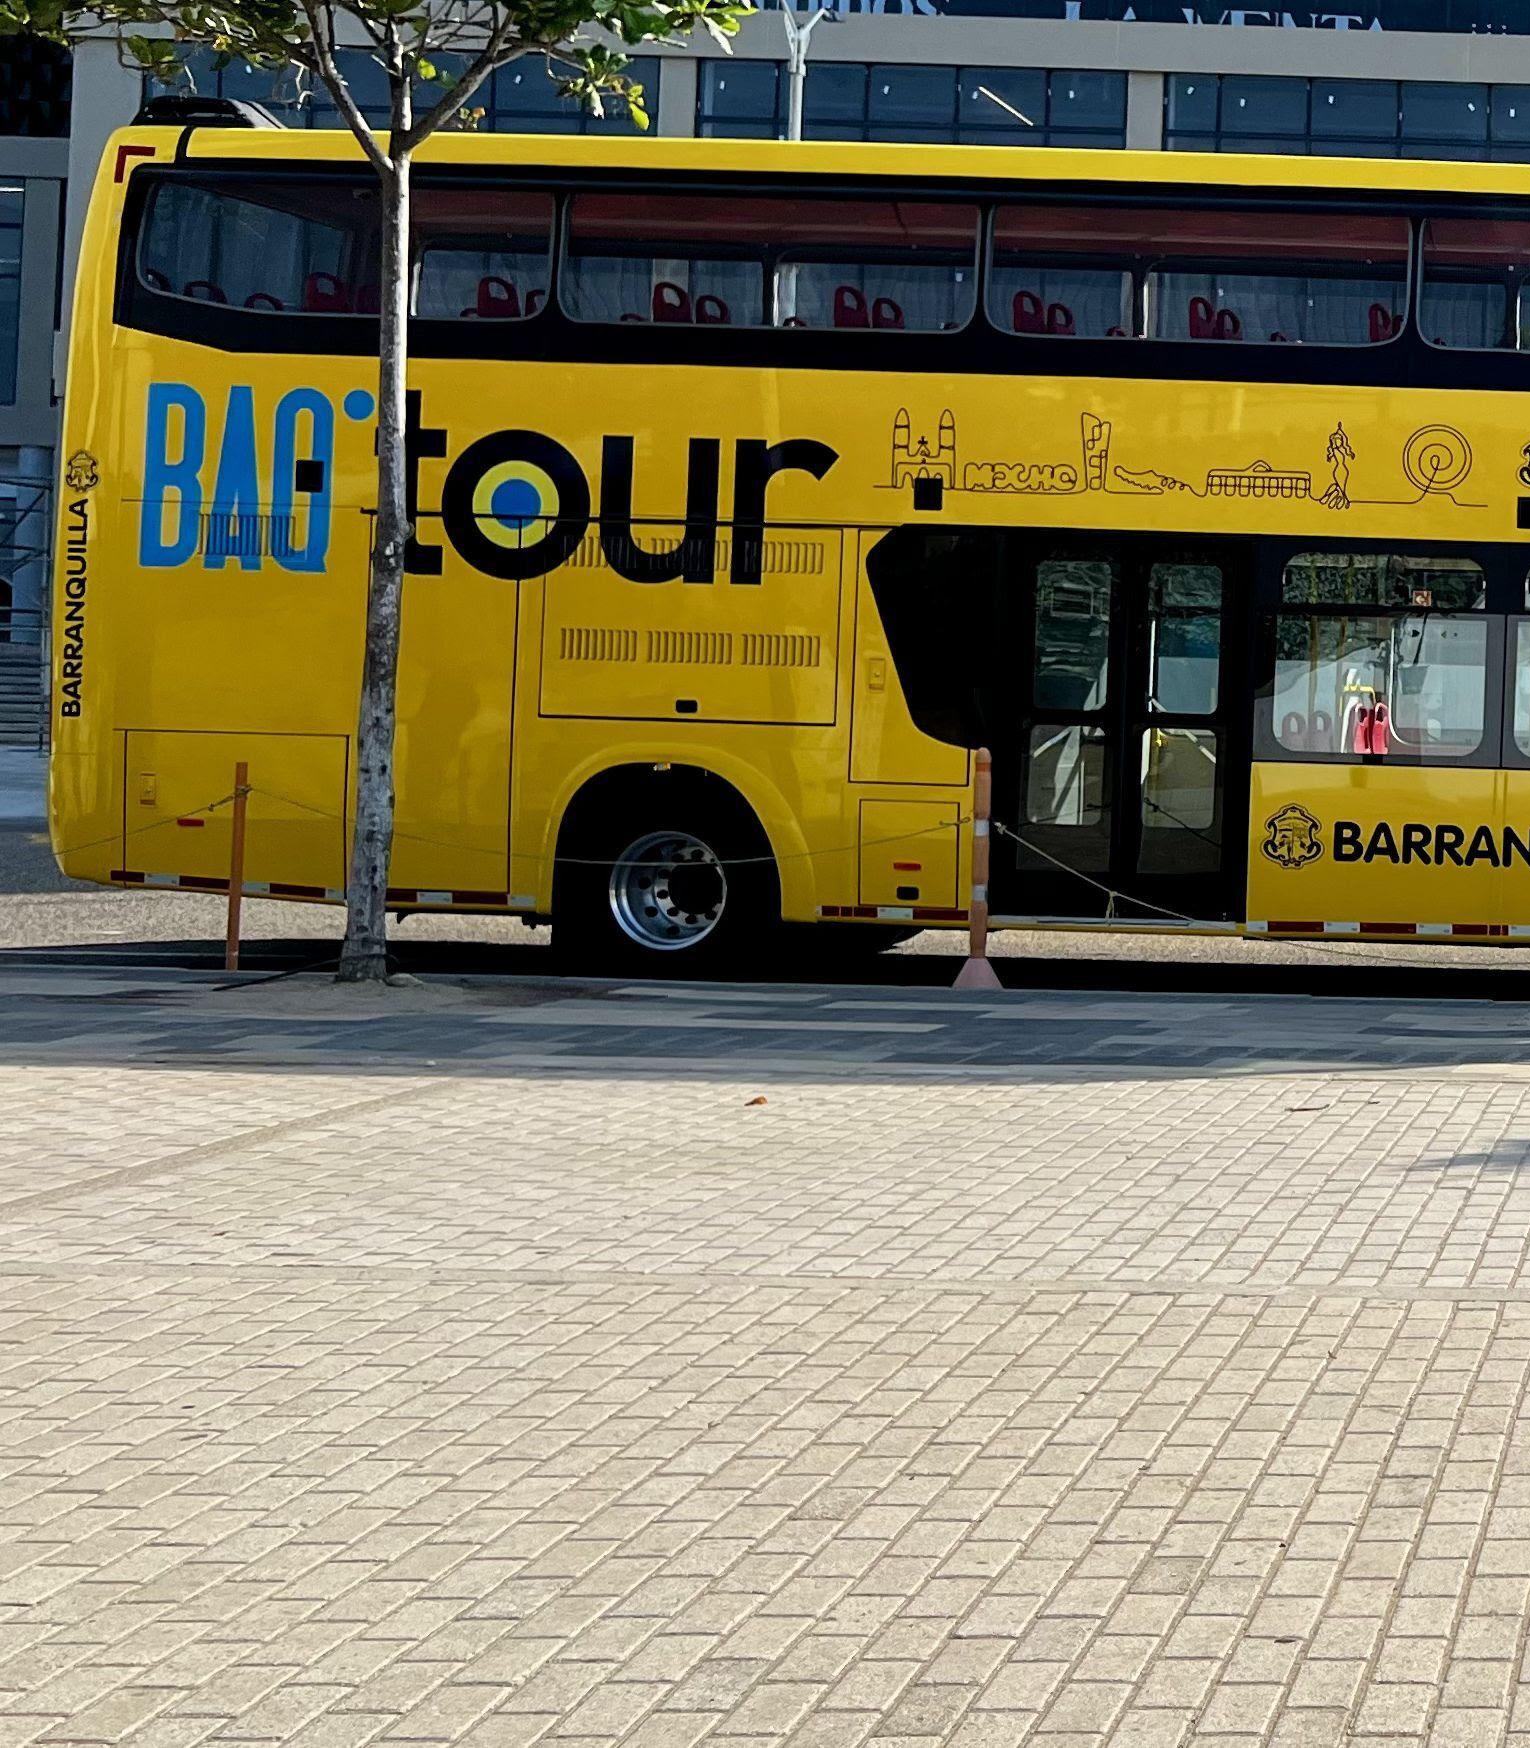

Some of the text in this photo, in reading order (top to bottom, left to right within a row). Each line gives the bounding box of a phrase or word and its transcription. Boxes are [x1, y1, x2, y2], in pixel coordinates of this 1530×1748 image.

[139, 382, 840, 585] BAQ tour
[61, 498, 89, 718] BARRANQUILLA
